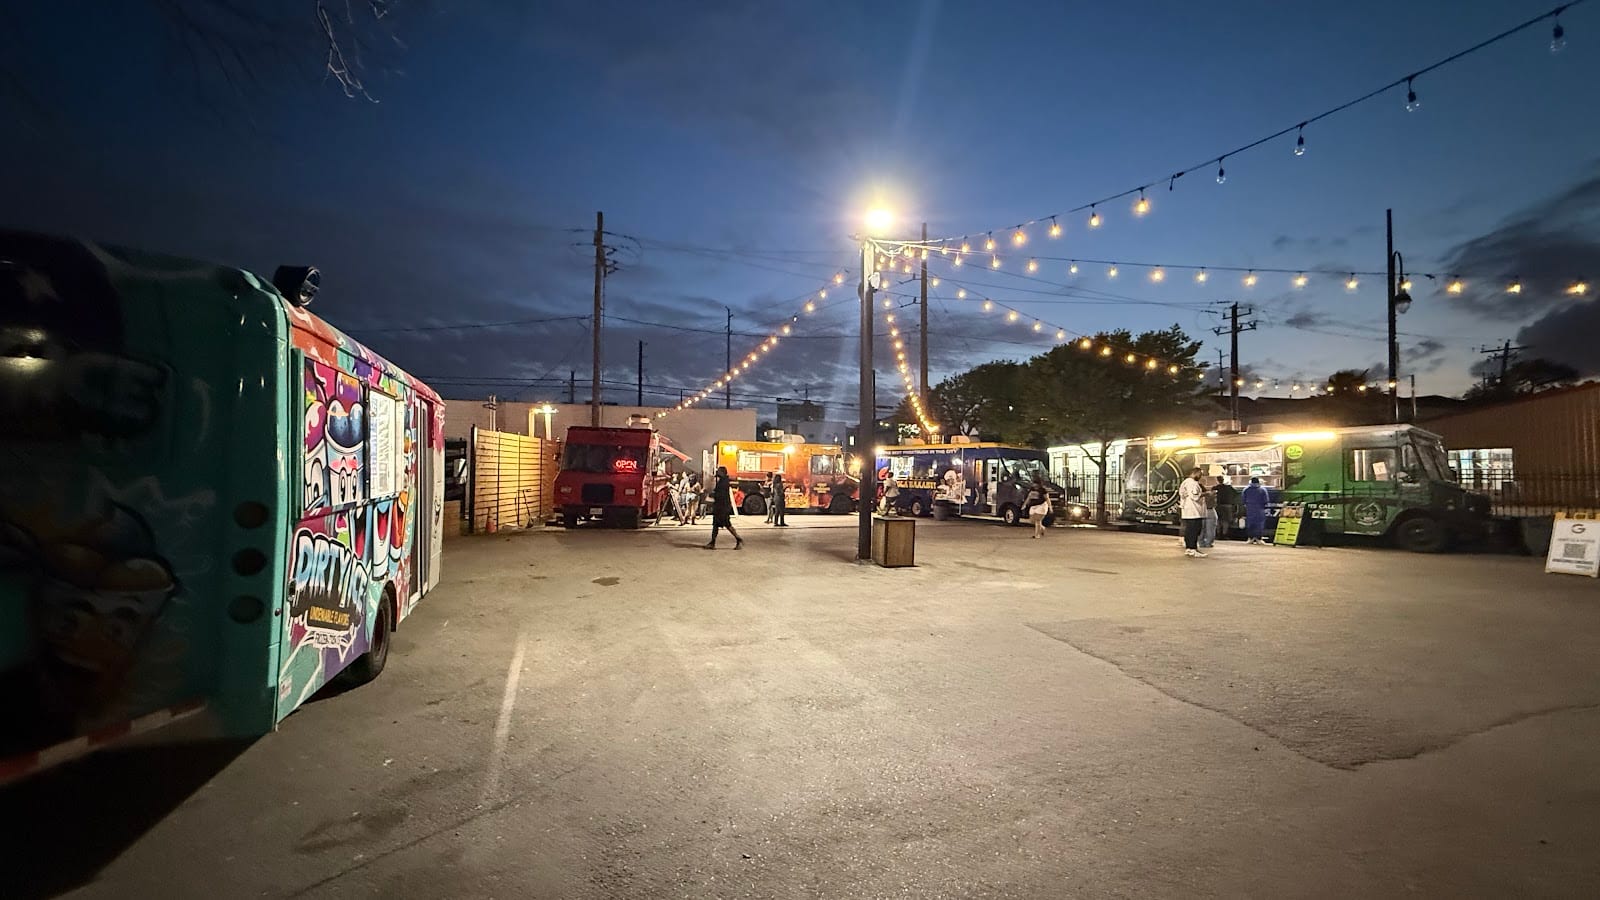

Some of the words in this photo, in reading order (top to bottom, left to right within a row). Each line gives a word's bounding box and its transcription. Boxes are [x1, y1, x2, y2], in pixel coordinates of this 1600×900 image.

[615, 460, 637, 469] OPEN
[1149, 493, 1168, 504] BROS
[1571, 523, 1586, 534] G
[294, 535, 351, 598] DIRTY
